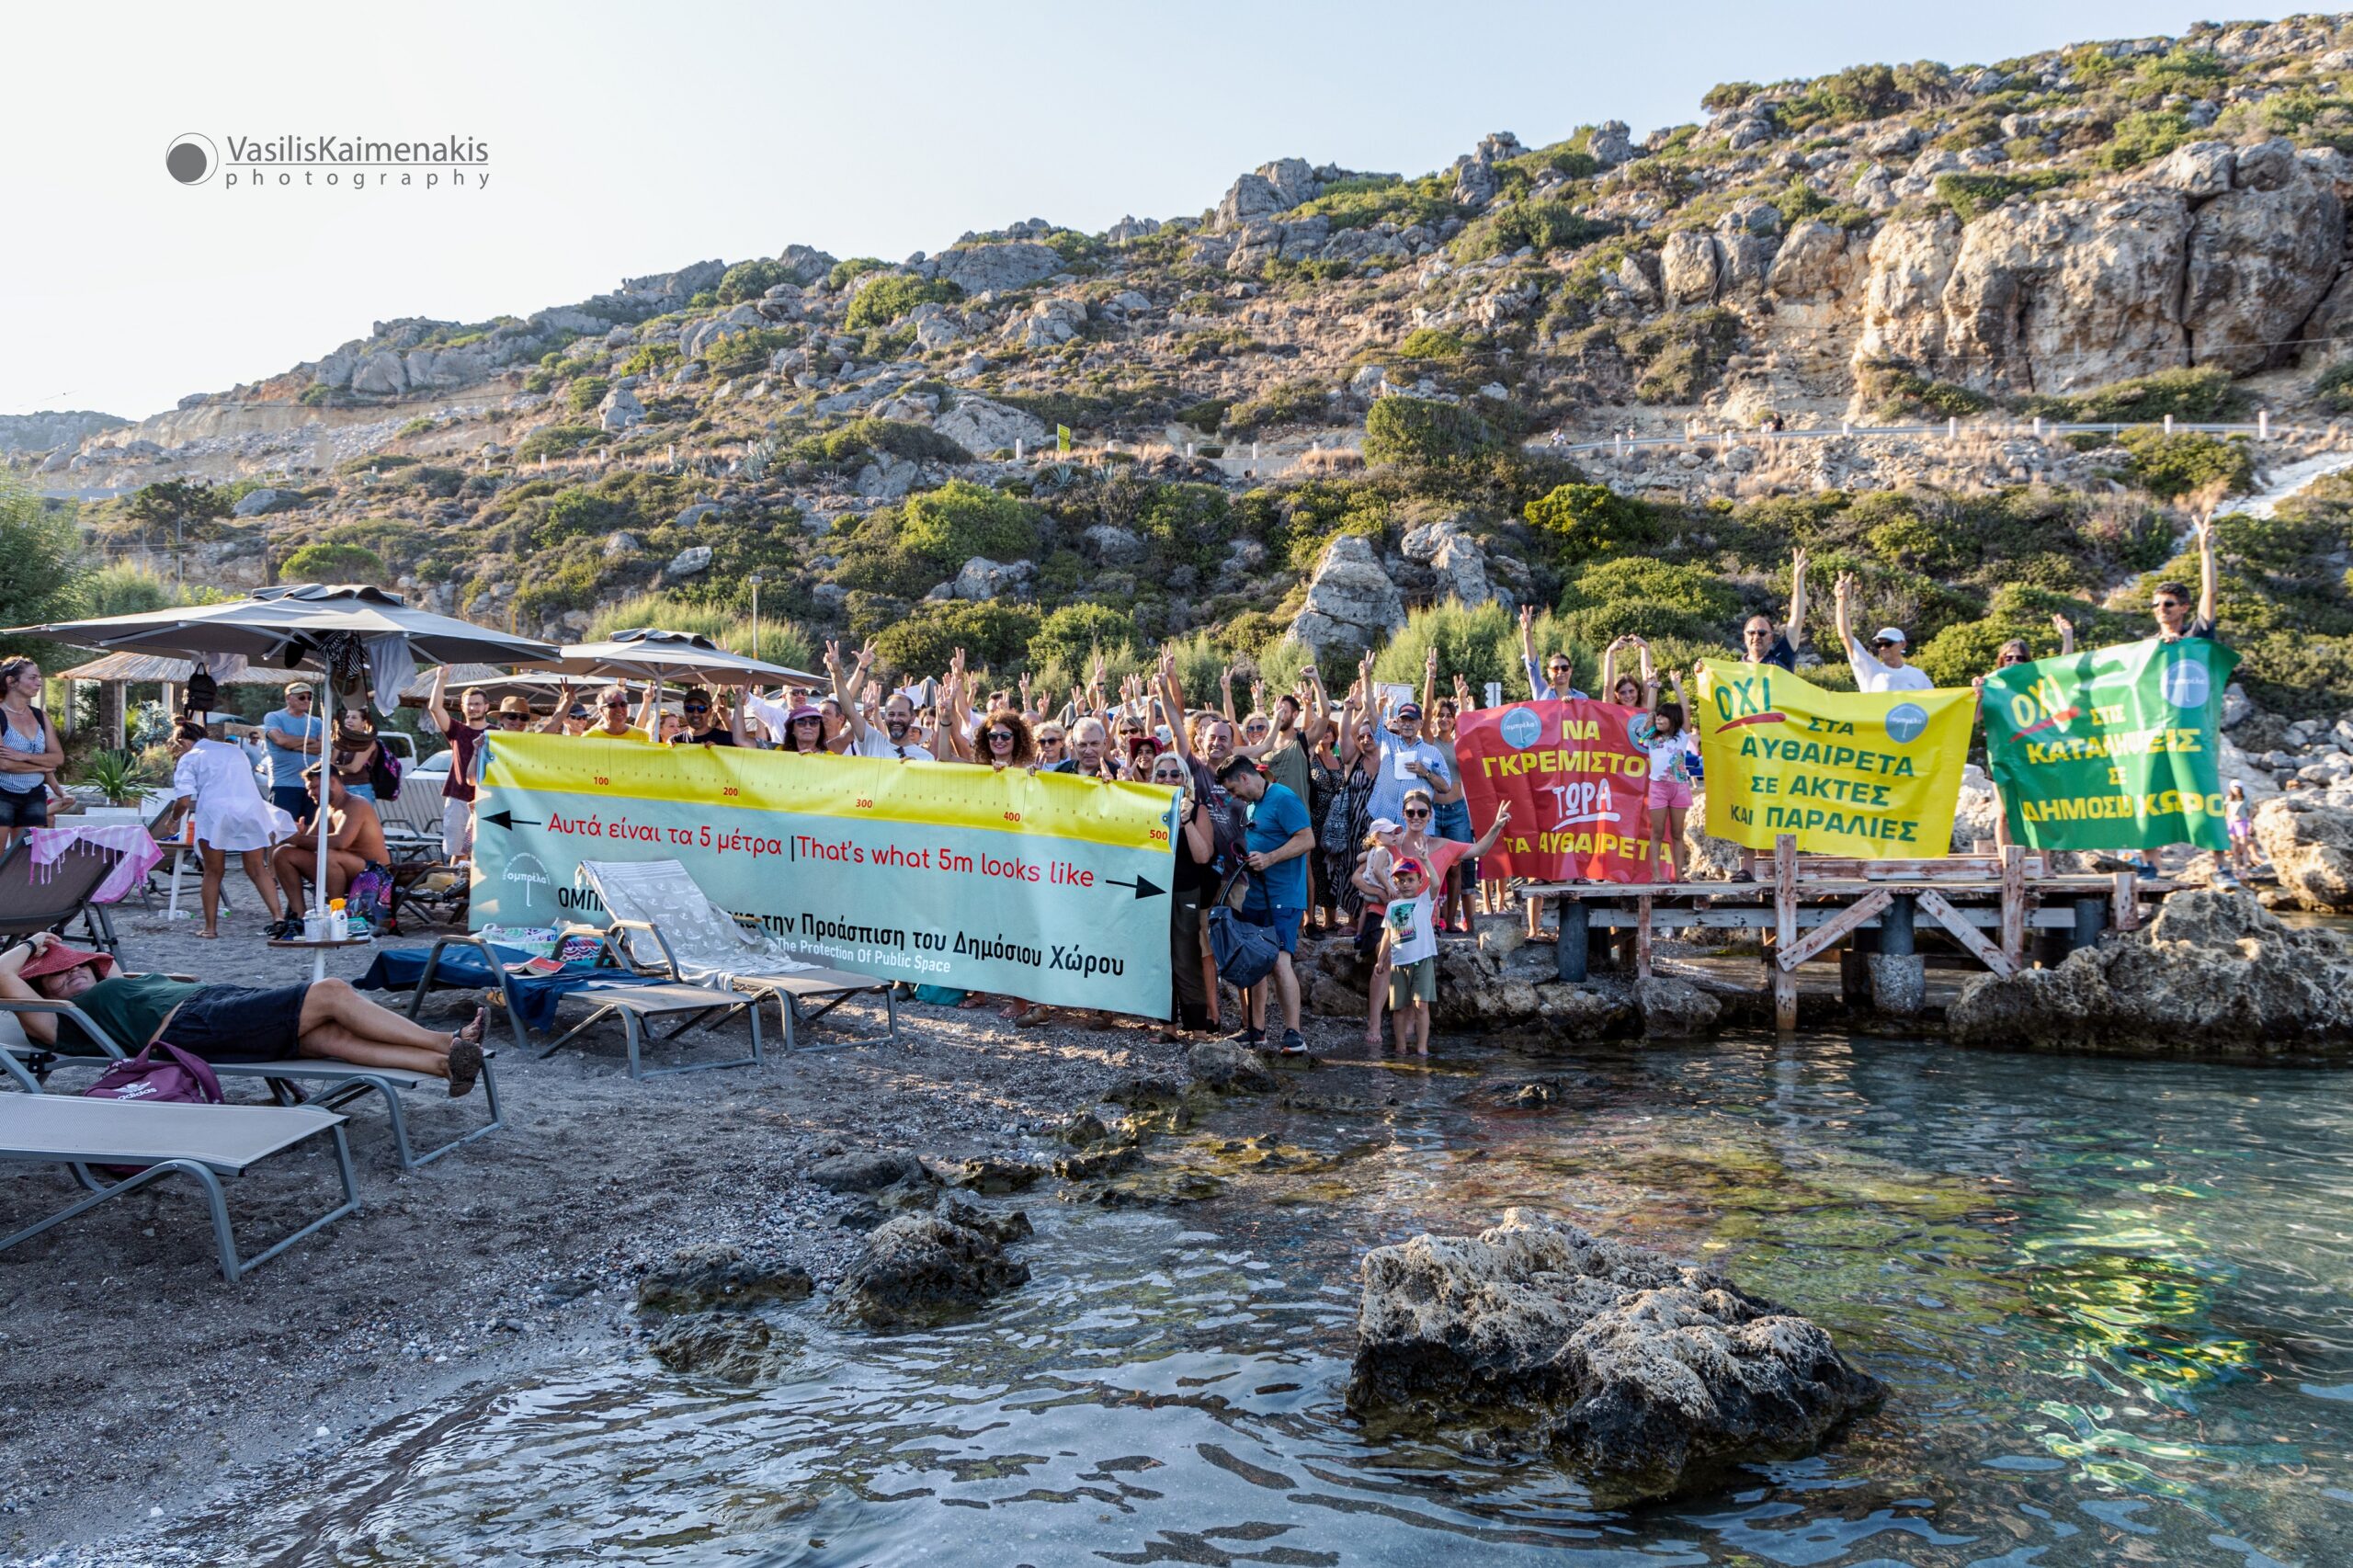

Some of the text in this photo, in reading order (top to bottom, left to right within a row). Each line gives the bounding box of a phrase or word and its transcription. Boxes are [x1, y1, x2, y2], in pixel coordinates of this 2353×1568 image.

[1715, 676, 1772, 722] ΟΧΙ
[2089, 703, 2127, 726] ΣΤΙΣ
[1563, 720, 1601, 741] ΝΑ
[1807, 715, 1855, 736] ΣΤΑ
[1482, 749, 1651, 778] ΓΚΡΕΜΙΣΤΟ
[1740, 735, 1915, 778] ΑΥΘΑΙΡΕΤΑ
[1750, 775, 1893, 807] ΣΕ ΑΚΤΕΣ
[2108, 766, 2128, 786] ΣΕ
[593, 776, 609, 786] 100
[722, 786, 739, 797] 200
[855, 798, 873, 809] 300
[1003, 811, 1021, 823] 400
[1149, 829, 1168, 841] 500
[1730, 804, 1920, 843] ΚΑΙ ΠΑΡΑΛΙΕΣ
[548, 812, 782, 858] Αυτά είναι τα 5 μέτρα
[1504, 831, 1675, 866] ΤΑ ΑΥΘΑΙΡΕΤΑ
[871, 844, 931, 869] what
[938, 847, 973, 874] 5m
[981, 852, 1041, 882] looks
[1050, 860, 1095, 888] like
[762, 914, 795, 937] την
[801, 913, 905, 951] Προάσπιση
[913, 931, 947, 951] του
[952, 930, 1042, 967] Δημόσιου
[1049, 944, 1124, 978] Χώρου
[776, 937, 797, 953] The
[800, 939, 854, 961] Protection
[857, 948, 872, 963] Of
[874, 949, 912, 969] Public
[914, 955, 952, 974] Space
[117, 1086, 158, 1101] adidas
